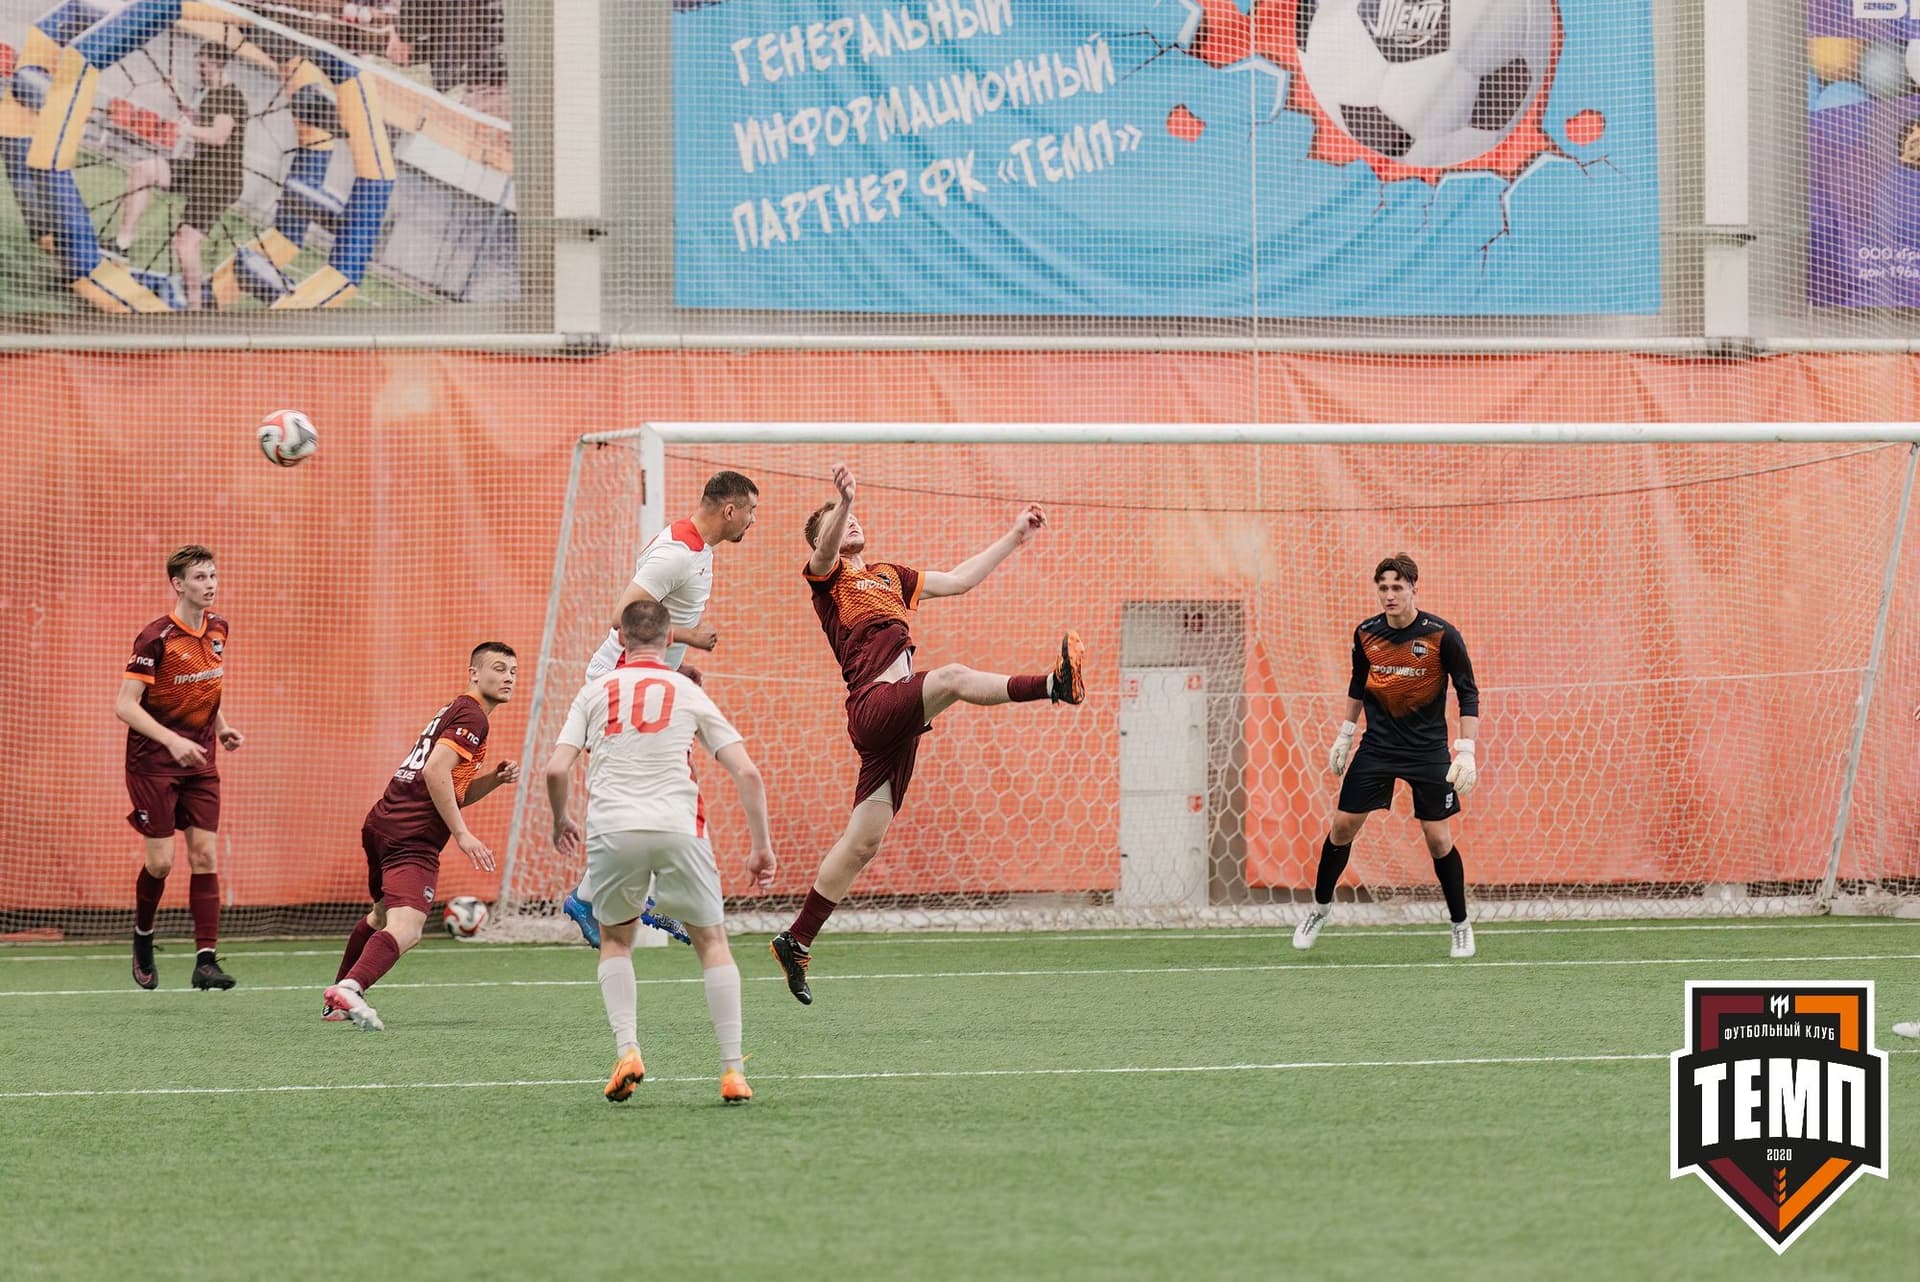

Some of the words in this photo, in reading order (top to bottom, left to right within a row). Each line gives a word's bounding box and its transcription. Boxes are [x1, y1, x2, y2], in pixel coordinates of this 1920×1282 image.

[733, 33, 1116, 173] ИНФОРМАЦИОННЫЙ
[732, 169, 908, 252] ПАРТНЕР
[918, 150, 987, 207] ФК
[998, 119, 1143, 188] «ТЕМП»
[603, 677, 676, 736] 10
